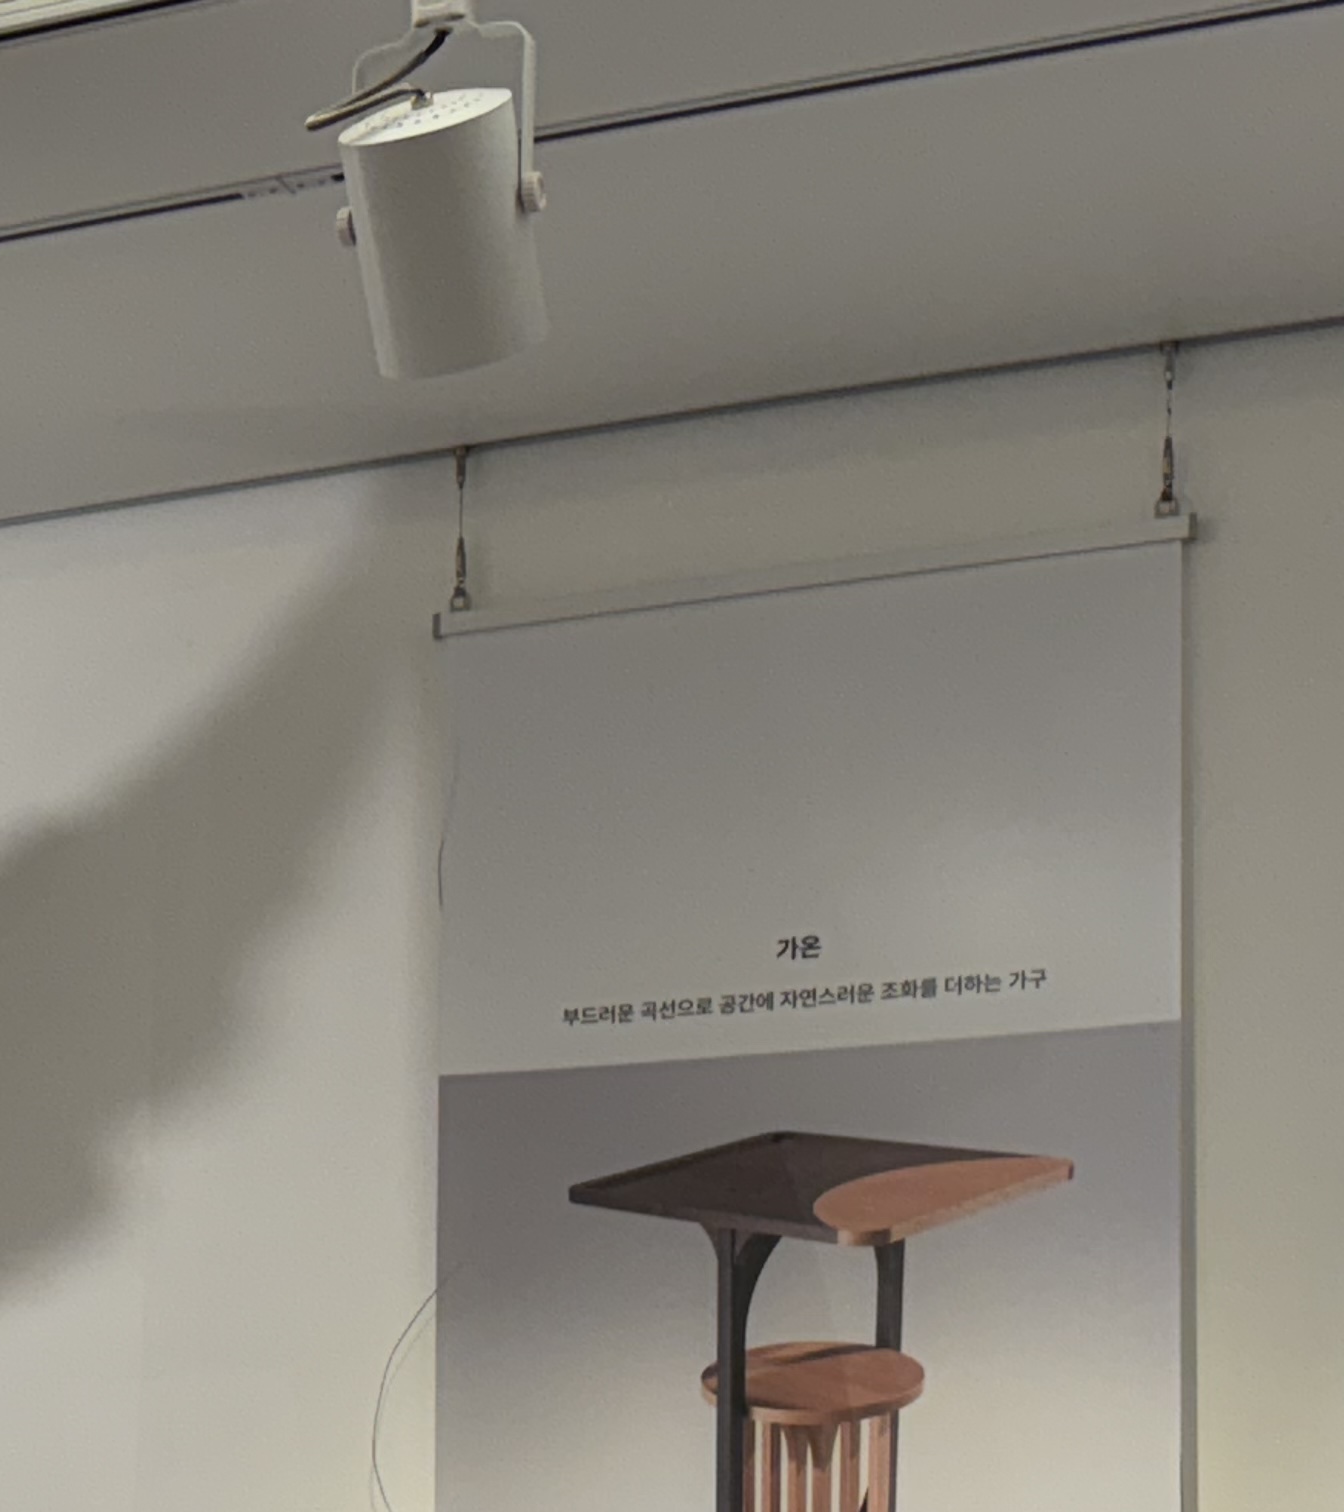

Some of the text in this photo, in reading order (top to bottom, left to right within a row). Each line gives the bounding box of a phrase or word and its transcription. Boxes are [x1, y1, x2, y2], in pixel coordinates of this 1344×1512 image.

[777, 935, 821, 960] 가온
[563, 969, 1047, 1026] 부드러운 곡선으로 공간에 자연스러운 조화를 더하는 가구
